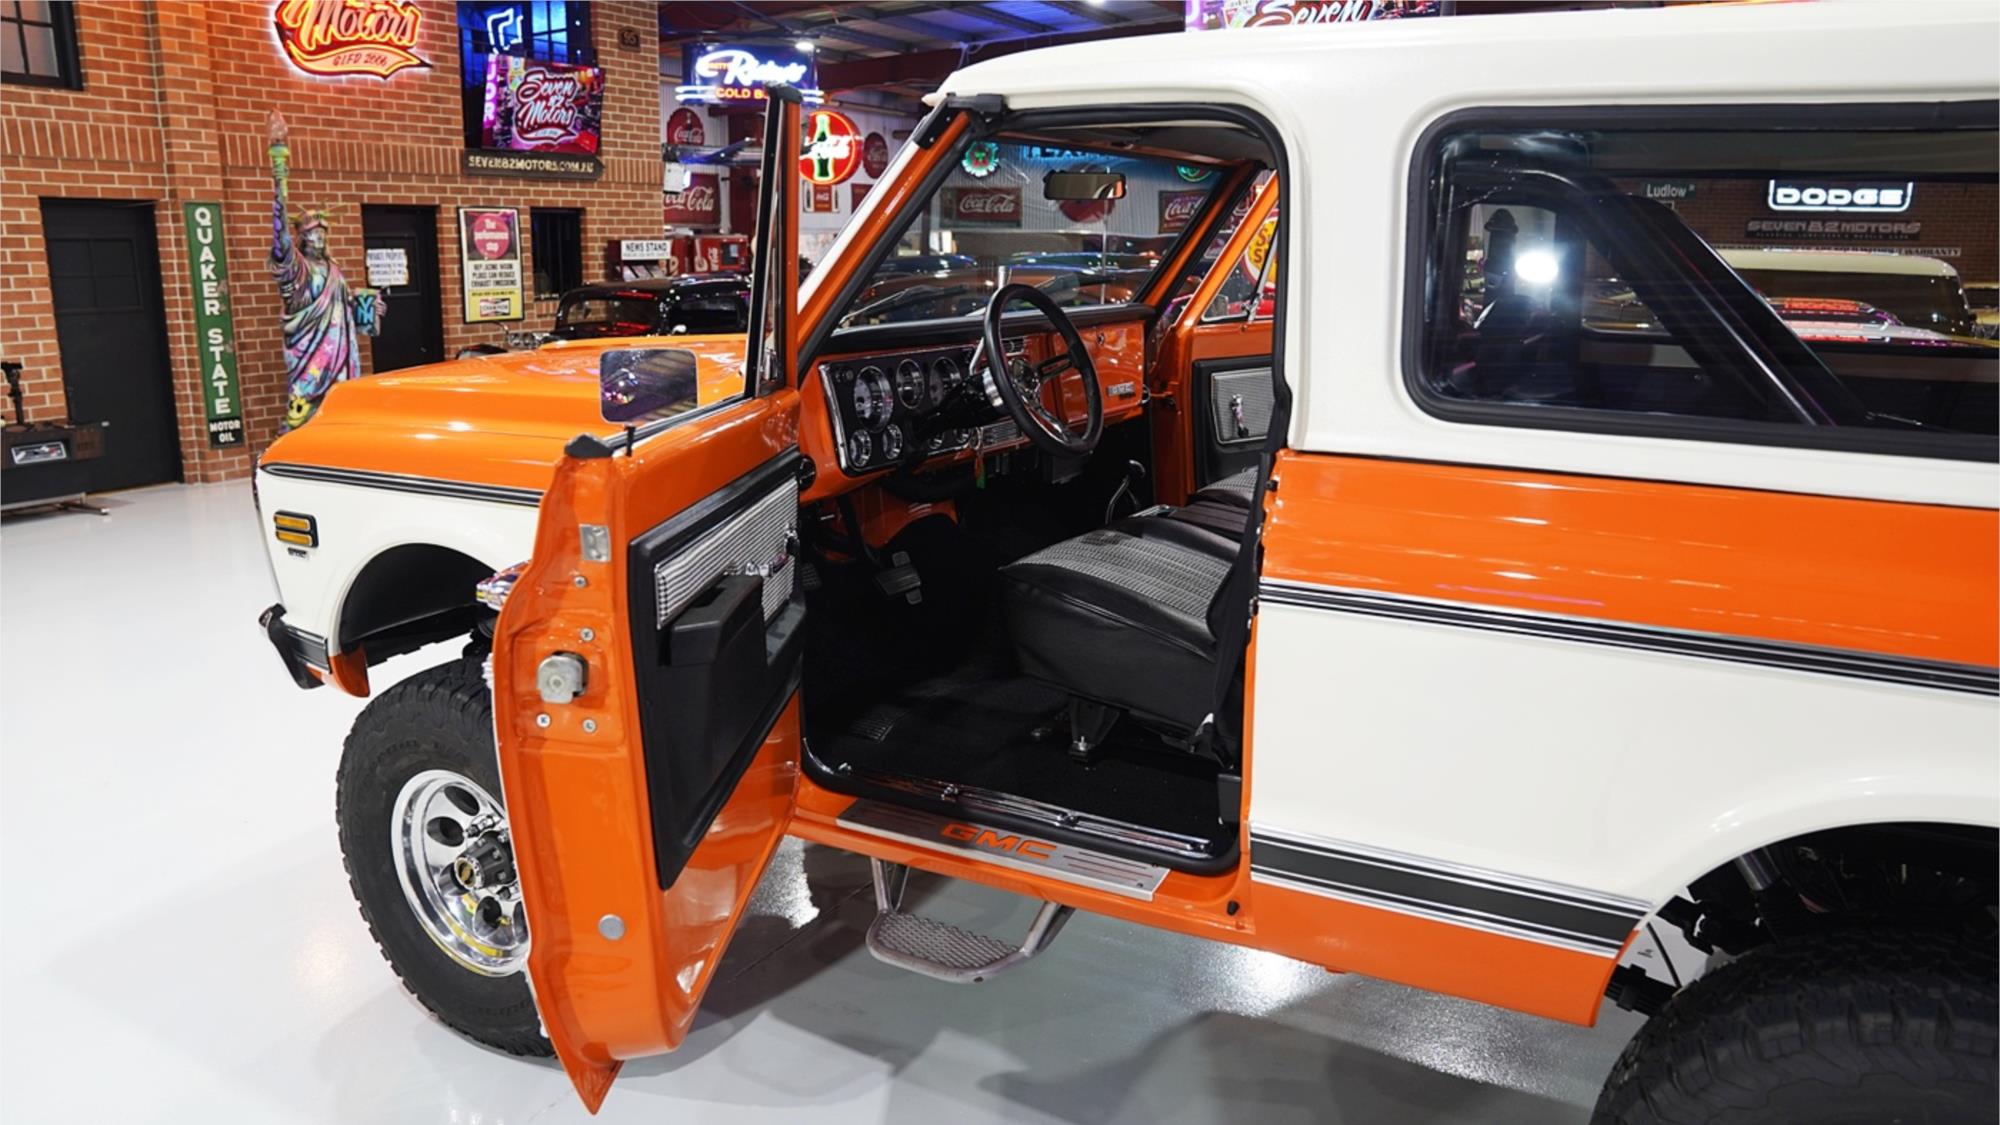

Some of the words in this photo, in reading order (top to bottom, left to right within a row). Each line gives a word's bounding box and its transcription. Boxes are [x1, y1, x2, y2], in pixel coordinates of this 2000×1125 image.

[283, 0, 421, 50] Motors
[518, 74, 574, 102] Seven
[716, 87, 751, 99] COLD
[518, 101, 574, 128] Motors
[1647, 183, 1686, 198] Ludlow
[1776, 187, 1904, 206] DODGE
[959, 193, 1016, 214] Coca-Cola
[1747, 220, 1807, 232] SEVEN
[1841, 222, 1921, 234] MOTORS
[625, 242, 644, 253] NEWS
[645, 242, 667, 252] STAND
[195, 207, 221, 316] QUAKER
[208, 328, 231, 414] STATE
[209, 419, 241, 432] MOTOR
[219, 432, 235, 443] OIL
[940, 823, 1057, 861] GMC
